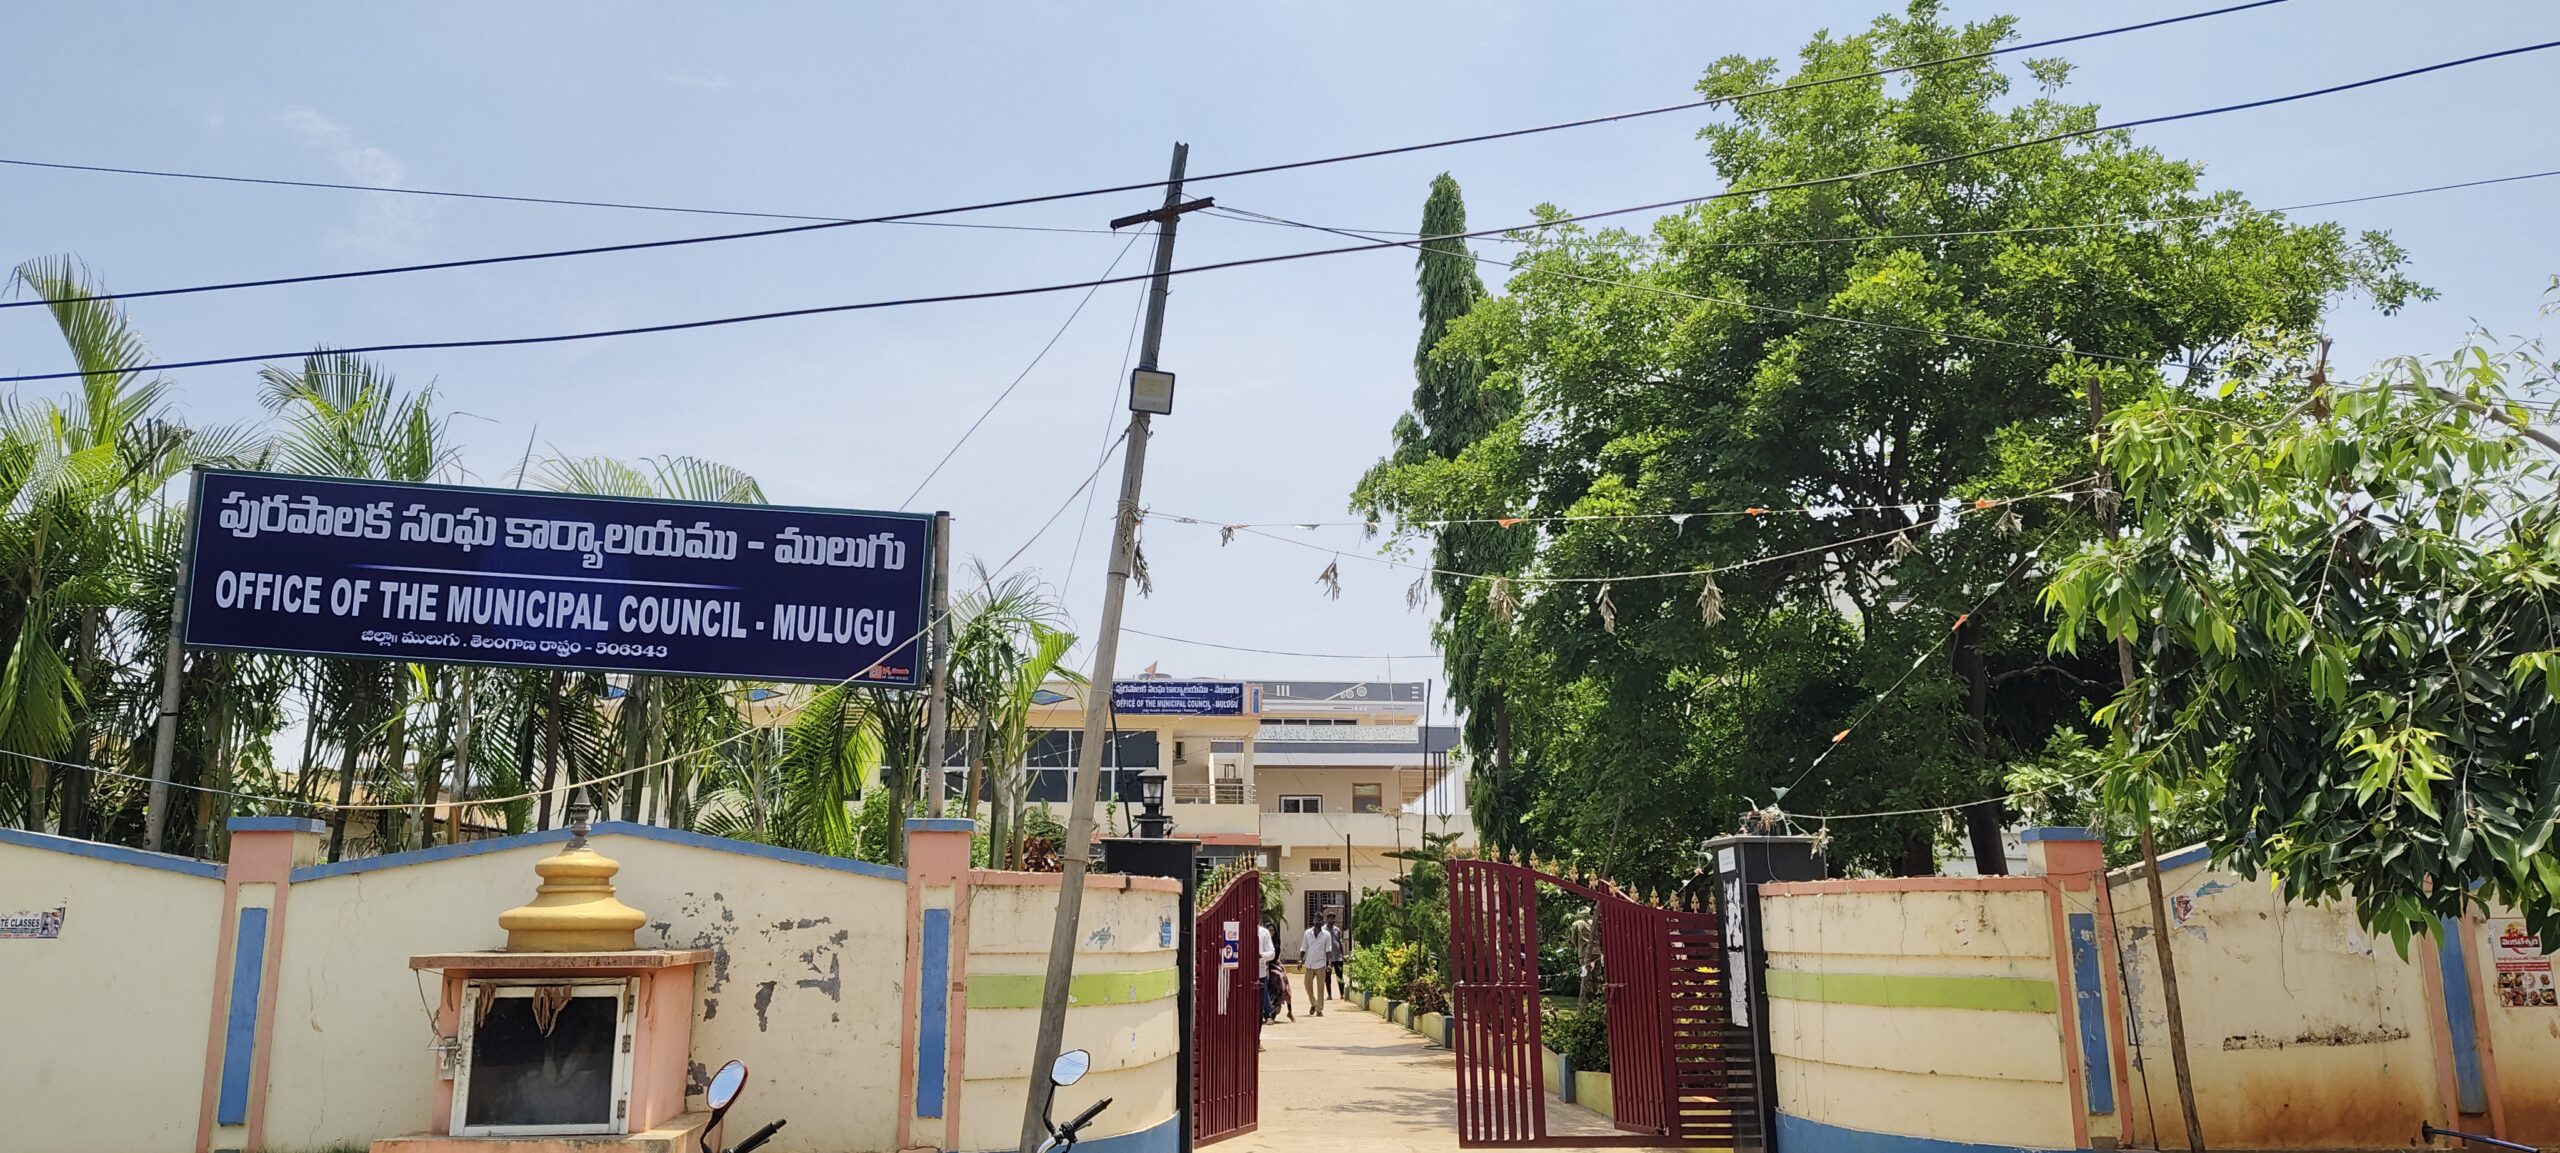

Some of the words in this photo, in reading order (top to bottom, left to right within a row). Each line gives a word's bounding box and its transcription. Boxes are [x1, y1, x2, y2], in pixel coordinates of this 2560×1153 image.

[219, 490, 394, 539] పురపాలక
[400, 503, 498, 552] సంఘ
[505, 515, 738, 569] కార్యాలయము
[748, 541, 765, 550] -
[774, 526, 906, 570] ములుగు
[215, 570, 323, 614] OFFICE
[330, 578, 371, 617] OF
[379, 581, 439, 621] THE
[446, 585, 609, 631] MUNICIPAL
[618, 595, 747, 639] COUNCIL
[772, 604, 896, 647] MULUGU
[401, 631, 461, 647] ములుగు
[470, 634, 537, 651] తెలంగాణ
[595, 642, 668, 658] 506343
[1115, 699, 1136, 709] OFFICE
[1137, 699, 1144, 708] OF
[1145, 699, 1156, 708] THE
[1157, 699, 1186, 709] MUNICIPAL
[1188, 699, 1211, 708] COUNCIL
[11, 918, 40, 928] CLASSES
